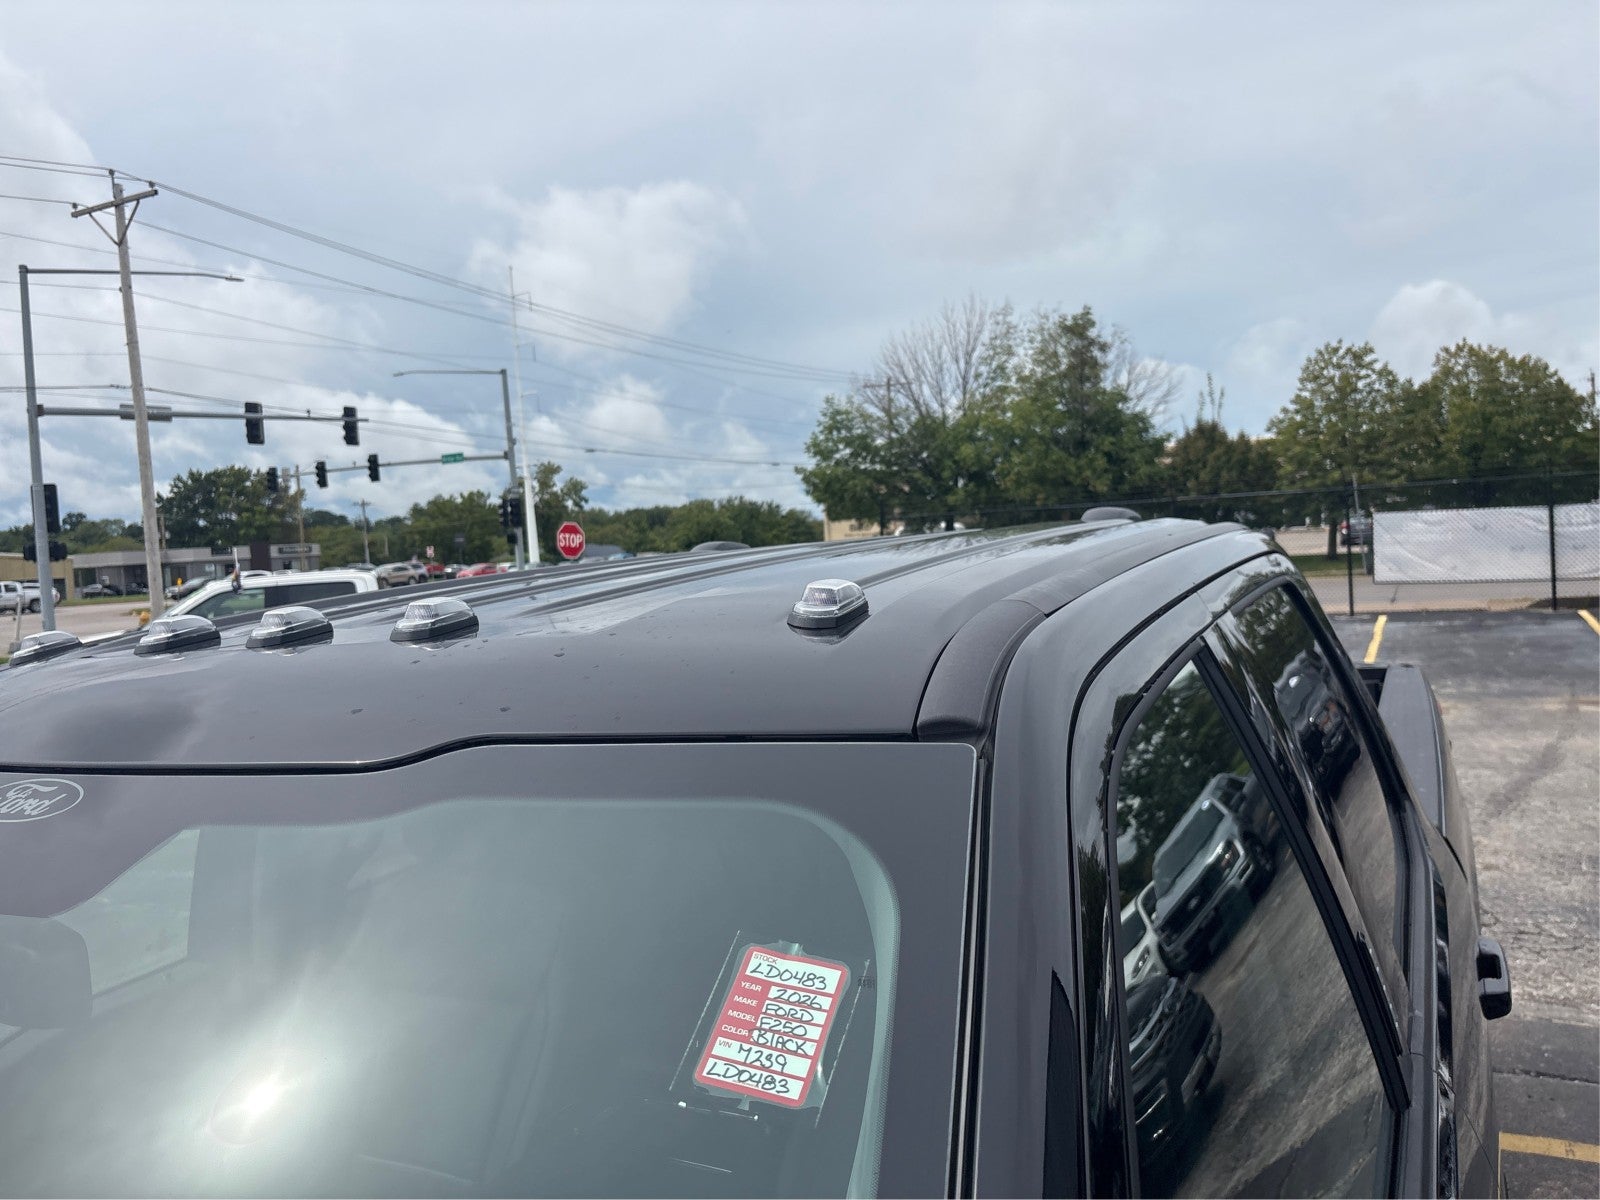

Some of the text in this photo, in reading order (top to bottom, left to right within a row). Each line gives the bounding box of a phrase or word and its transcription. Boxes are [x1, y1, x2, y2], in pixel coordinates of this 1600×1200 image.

[560, 533, 583, 548] STOP
[0, 784, 68, 815] Ford
[751, 953, 778, 964] STOCK
[741, 981, 823, 1010] YEAR 2026
[733, 995, 814, 1022] MAKE FORD
[722, 1024, 749, 1037] COLOR
[727, 1009, 807, 1037] MODEL F250
[718, 1039, 732, 1049] VIN
